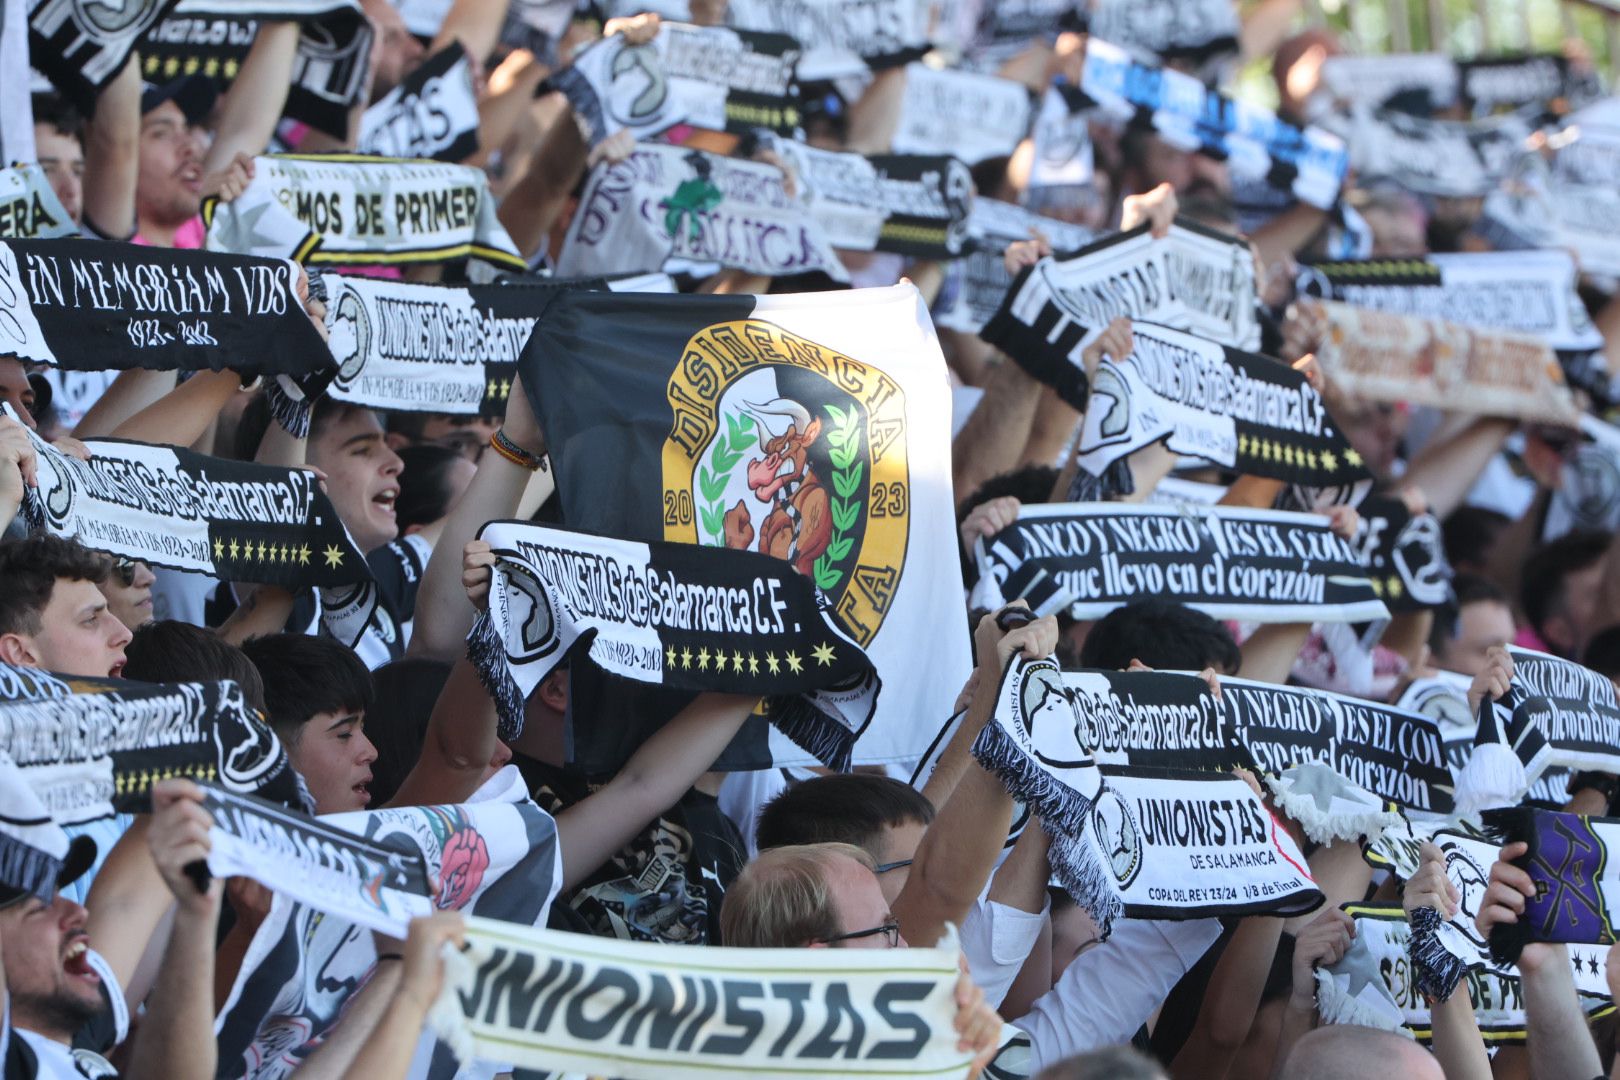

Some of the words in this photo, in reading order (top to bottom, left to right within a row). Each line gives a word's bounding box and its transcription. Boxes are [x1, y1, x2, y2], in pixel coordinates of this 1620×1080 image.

[355, 193, 385, 236] DE
[233, 265, 288, 316] VDS
[669, 323, 904, 464] DISIDENCIA
[176, 464, 294, 525] Salamanca
[664, 489, 692, 526] 20
[870, 481, 907, 518] 23
[1108, 516, 1201, 553] NEGRO
[624, 564, 651, 629] de
[645, 563, 753, 635] Salamanca
[753, 577, 801, 634] C.F.
[1101, 551, 1164, 597] llevo
[1166, 562, 1199, 595] en
[1202, 551, 1226, 595] el
[1228, 560, 1326, 604] corazón
[1110, 691, 1201, 751] Salamanca
[1223, 687, 1242, 727] Y
[1241, 688, 1322, 735] NEGRO
[1371, 710, 1396, 754] EL
[1137, 797, 1268, 848] UNIONISTAS
[1189, 854, 1206, 870] DE
[1205, 849, 1278, 870] SALAMANCA
[1148, 887, 1173, 902] COPA
[1173, 889, 1188, 903] DEL
[1188, 888, 1209, 903] REY
[1209, 887, 1238, 902] 23/24
[1242, 884, 1260, 899] 1/8
[1261, 883, 1275, 897] de
[1275, 876, 1305, 895] final
